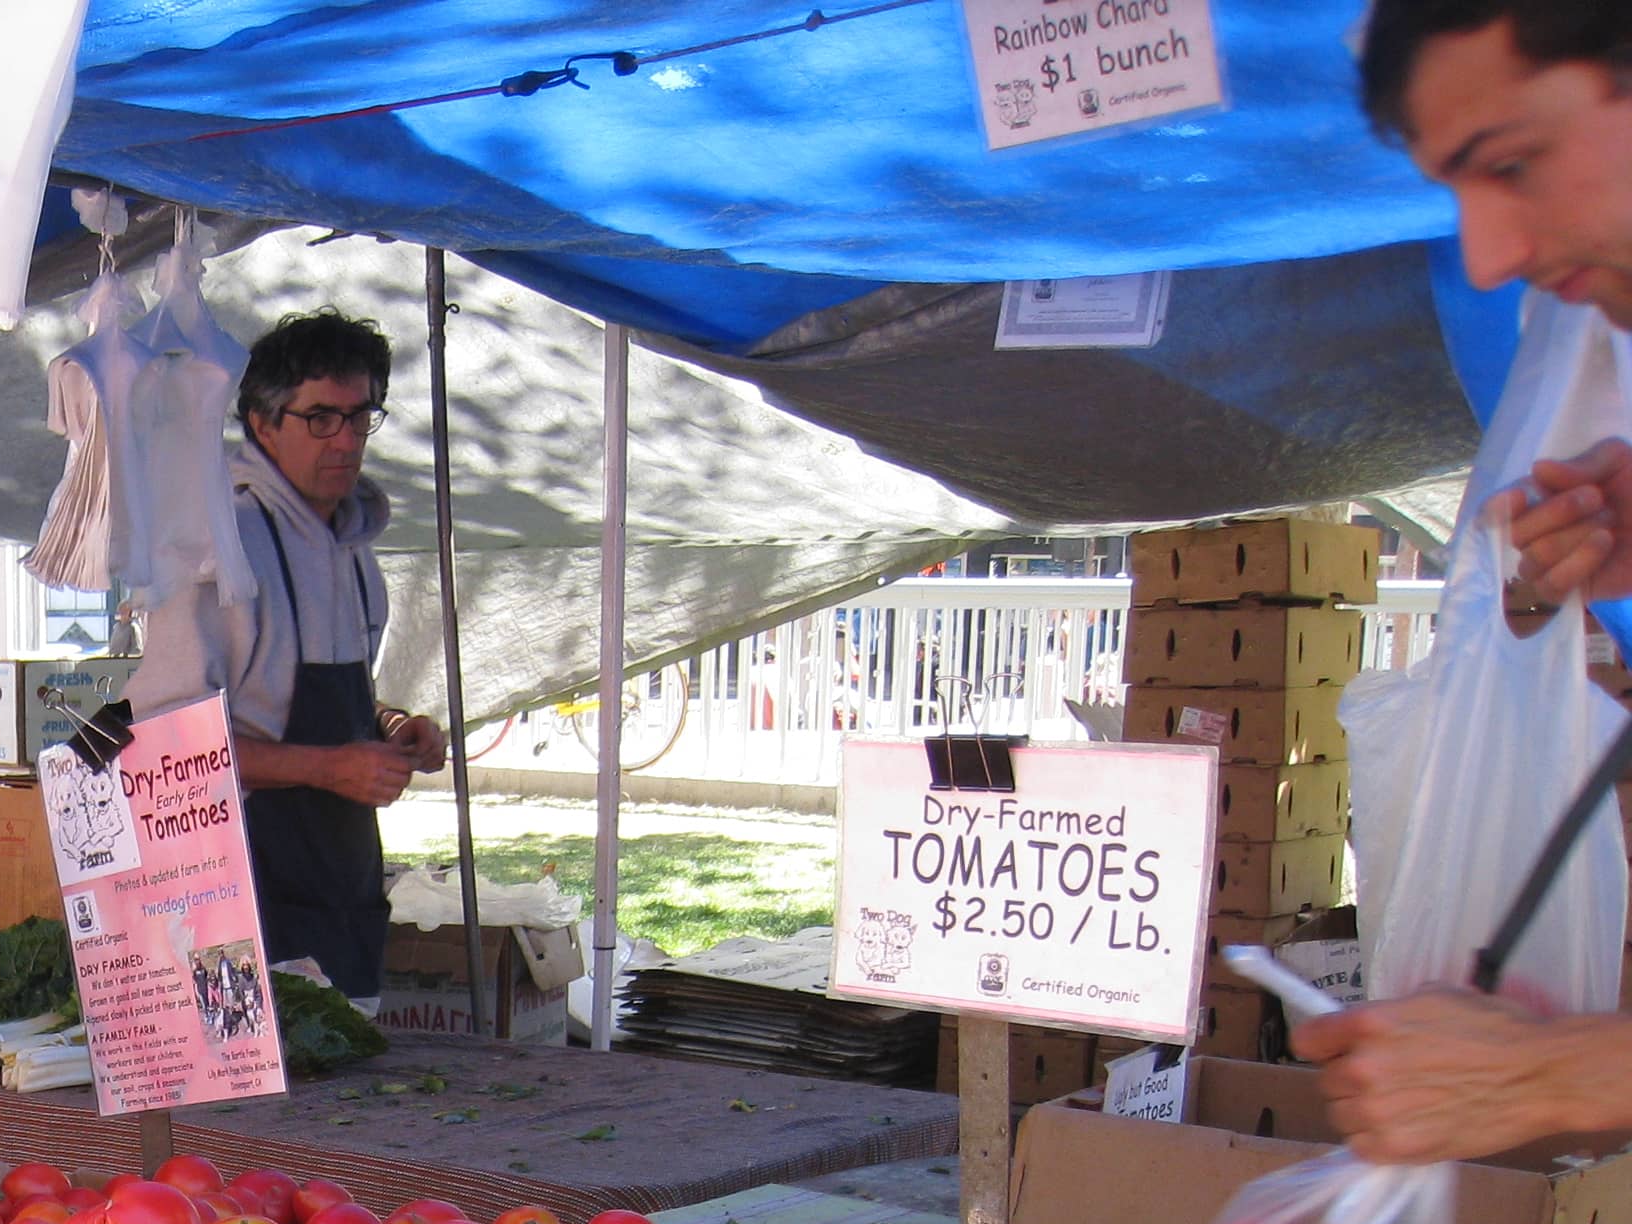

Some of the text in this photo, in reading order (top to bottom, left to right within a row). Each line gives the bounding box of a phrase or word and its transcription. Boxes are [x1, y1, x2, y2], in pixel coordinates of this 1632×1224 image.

[994, 13, 1088, 54] Rainbow
[1041, 29, 1188, 93] $1 bunch
[47, 755, 74, 778] Two
[119, 736, 232, 799] Dry-Farmed
[155, 781, 210, 811] Early Girl
[139, 798, 230, 843] Tomatoes
[923, 794, 1127, 837] Dry-Farmed
[114, 877, 141, 895] Photos
[142, 874, 149, 887] &
[148, 866, 180, 888] updated
[180, 861, 201, 878] farm
[201, 855, 218, 872] info
[883, 829, 1161, 903] TOMATOES
[141, 882, 240, 919] twodogfarm.biz
[860, 907, 913, 928] Two Dog
[74, 930, 129, 952] Certified Organic
[932, 890, 1171, 956] $2.50 / Lb.
[79, 962, 100, 978] DRY
[102, 954, 144, 975] FARMED
[1021, 976, 1142, 1005] Certified Organic
[91, 1034, 98, 1045] A
[99, 1027, 133, 1044] FAMILY
[133, 1023, 157, 1038] FARM
[1144, 1073, 1169, 1095] Good
